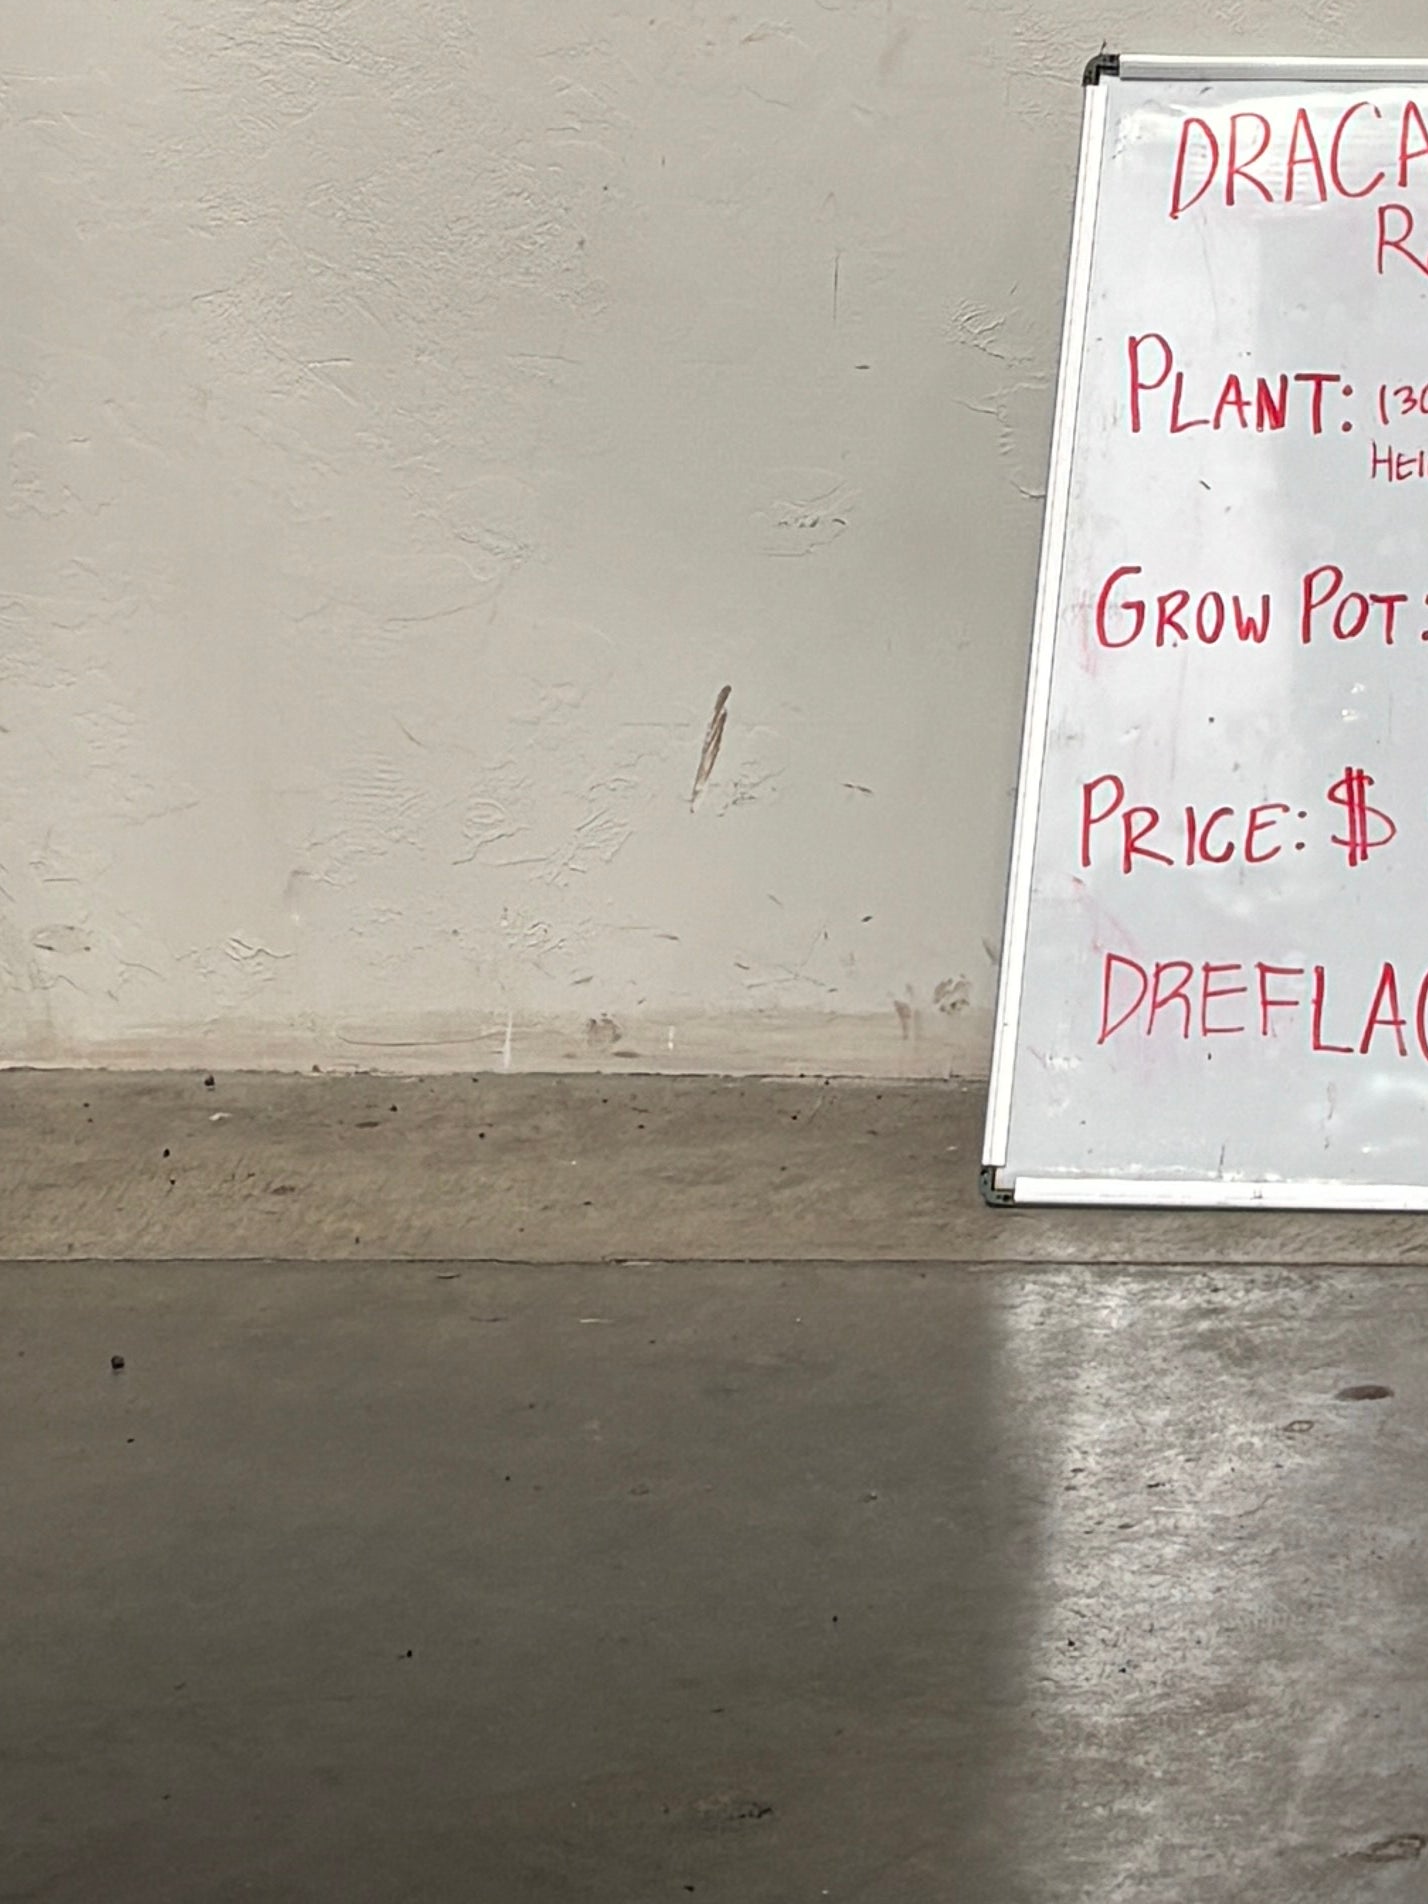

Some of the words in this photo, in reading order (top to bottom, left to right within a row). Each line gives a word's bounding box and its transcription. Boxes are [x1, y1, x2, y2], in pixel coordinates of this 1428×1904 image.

[1127, 332, 1353, 436] PLANT:
[1094, 565, 1271, 649] GROW
[1080, 772, 1309, 875] PRICE:
